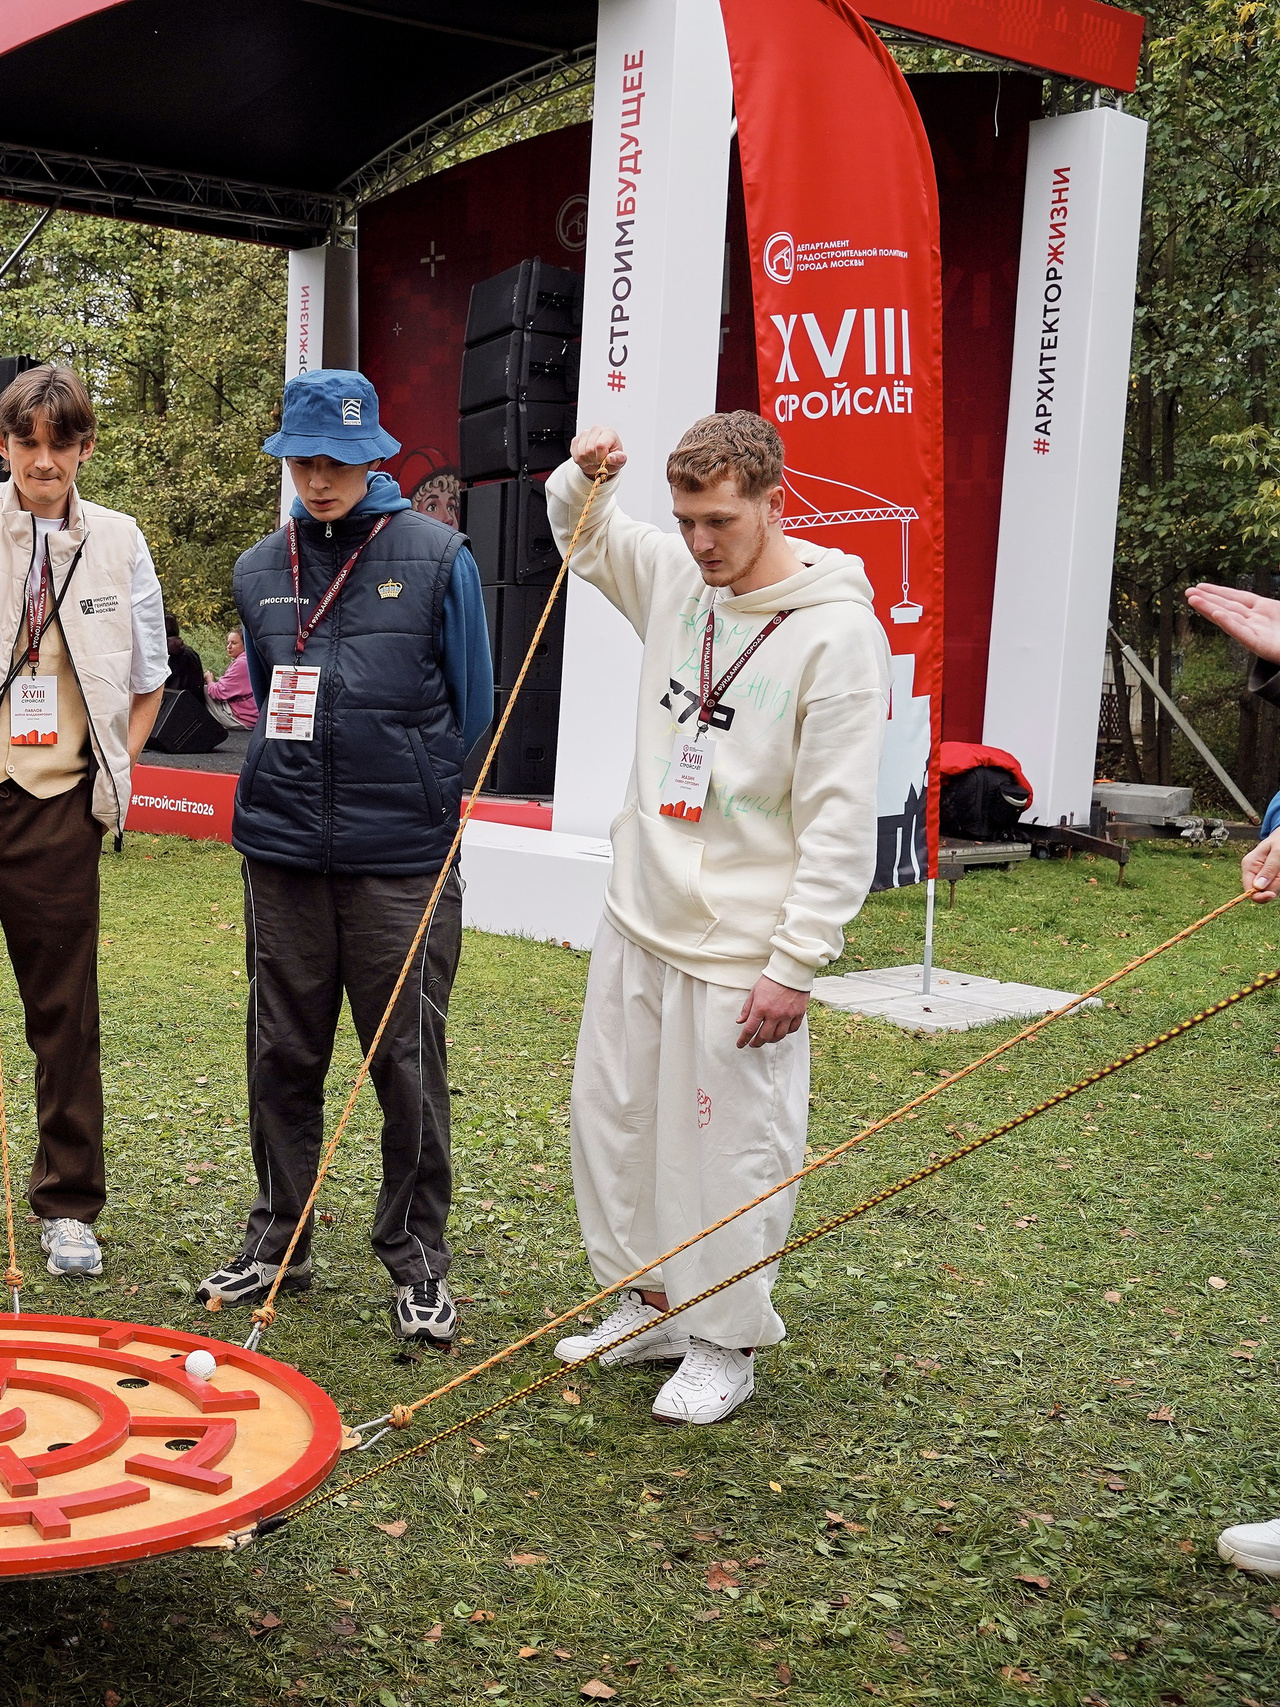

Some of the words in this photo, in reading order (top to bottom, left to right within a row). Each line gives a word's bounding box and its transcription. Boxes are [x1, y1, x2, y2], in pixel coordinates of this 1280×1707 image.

[607, 49, 646, 393] #СТРОИМБУДУЩЕЕ
[796, 240, 850, 252] ДЕПАРТАМЕНТ
[796, 248, 877, 262] ГРАДОСТРОИТЕЛЬНОЙ
[878, 249, 908, 259] ПОЛИТИКИ
[796, 262, 828, 271] ГОРОДА
[830, 259, 865, 269] МОСКВЫ
[1032, 166, 1071, 455] #АРХИТЕКТОРЖИЗНИ
[770, 307, 911, 383] XVIII
[311, 591, 335, 624] ФУНДАМЕНТ
[331, 569, 348, 592] ГОРОДА
[703, 642, 711, 680] ФУНДАМЕНТ
[717, 656, 746, 692] ФУНДАМЕНТ
[744, 633, 766, 658] ГОРОДА
[22, 690, 45, 698] XVIII
[681, 752, 703, 765] XVIII
[131, 794, 215, 816] #СТРОЙСЛЁТ2026
